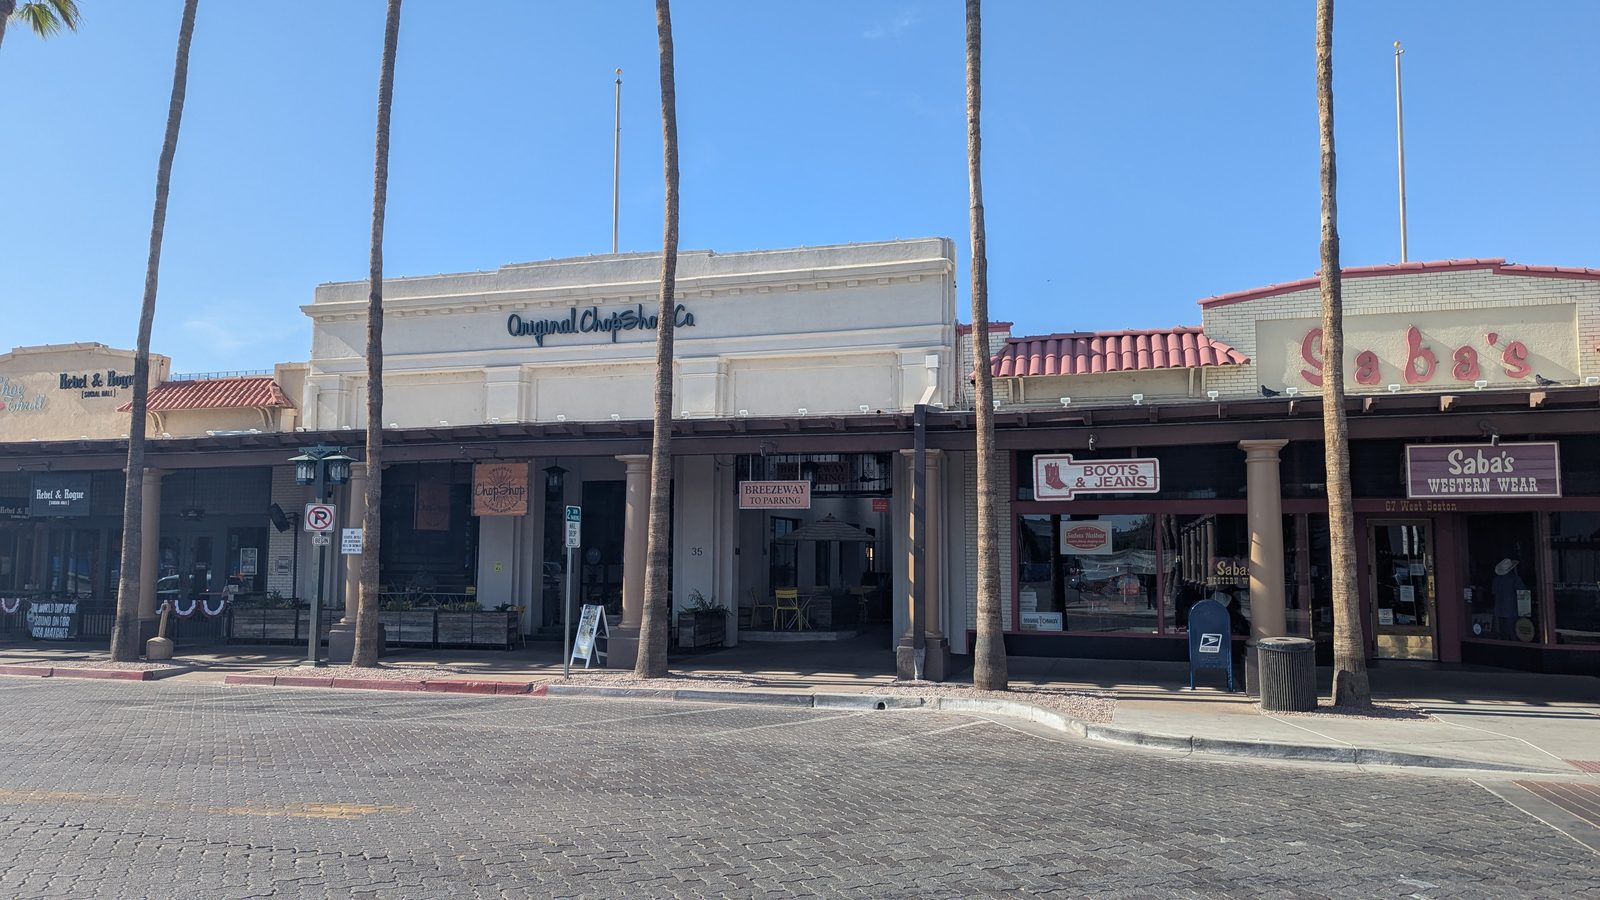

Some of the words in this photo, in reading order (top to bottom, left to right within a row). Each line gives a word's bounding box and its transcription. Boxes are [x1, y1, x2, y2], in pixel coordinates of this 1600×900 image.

[508, 307, 579, 347] Original
[580, 304, 657, 343] ChopSho
[1299, 324, 1532, 387] Saba's
[60, 373, 87, 389] Rebel
[92, 373, 103, 387] &
[107, 370, 135, 389] Rogu
[1448, 449, 1514, 475] Saba's
[1084, 464, 1139, 476] BOOTS
[1075, 477, 1086, 487] &
[1095, 476, 1148, 487] JEANS
[1428, 478, 1490, 493] WESTERN
[1497, 477, 1538, 492] WEAR
[36, 489, 53, 499] Rebel
[55, 490, 62, 499] &
[64, 488, 84, 500] Rogue
[475, 480, 526, 502] ChopShop
[745, 485, 806, 495] BREEZEWAY
[763, 496, 801, 505] PARKING
[1400, 501, 1422, 511] West
[1427, 501, 1457, 511] Boston
[692, 548, 703, 556] 35
[1206, 576, 1239, 585] WESTERN
[39, 603, 54, 613] WORLD
[55, 604, 63, 613] CUP
[34, 615, 52, 626] SOUND
[52, 615, 59, 626] ON
[60, 616, 70, 627] FOR
[32, 627, 44, 637] USA
[44, 627, 68, 638] MATCHES
